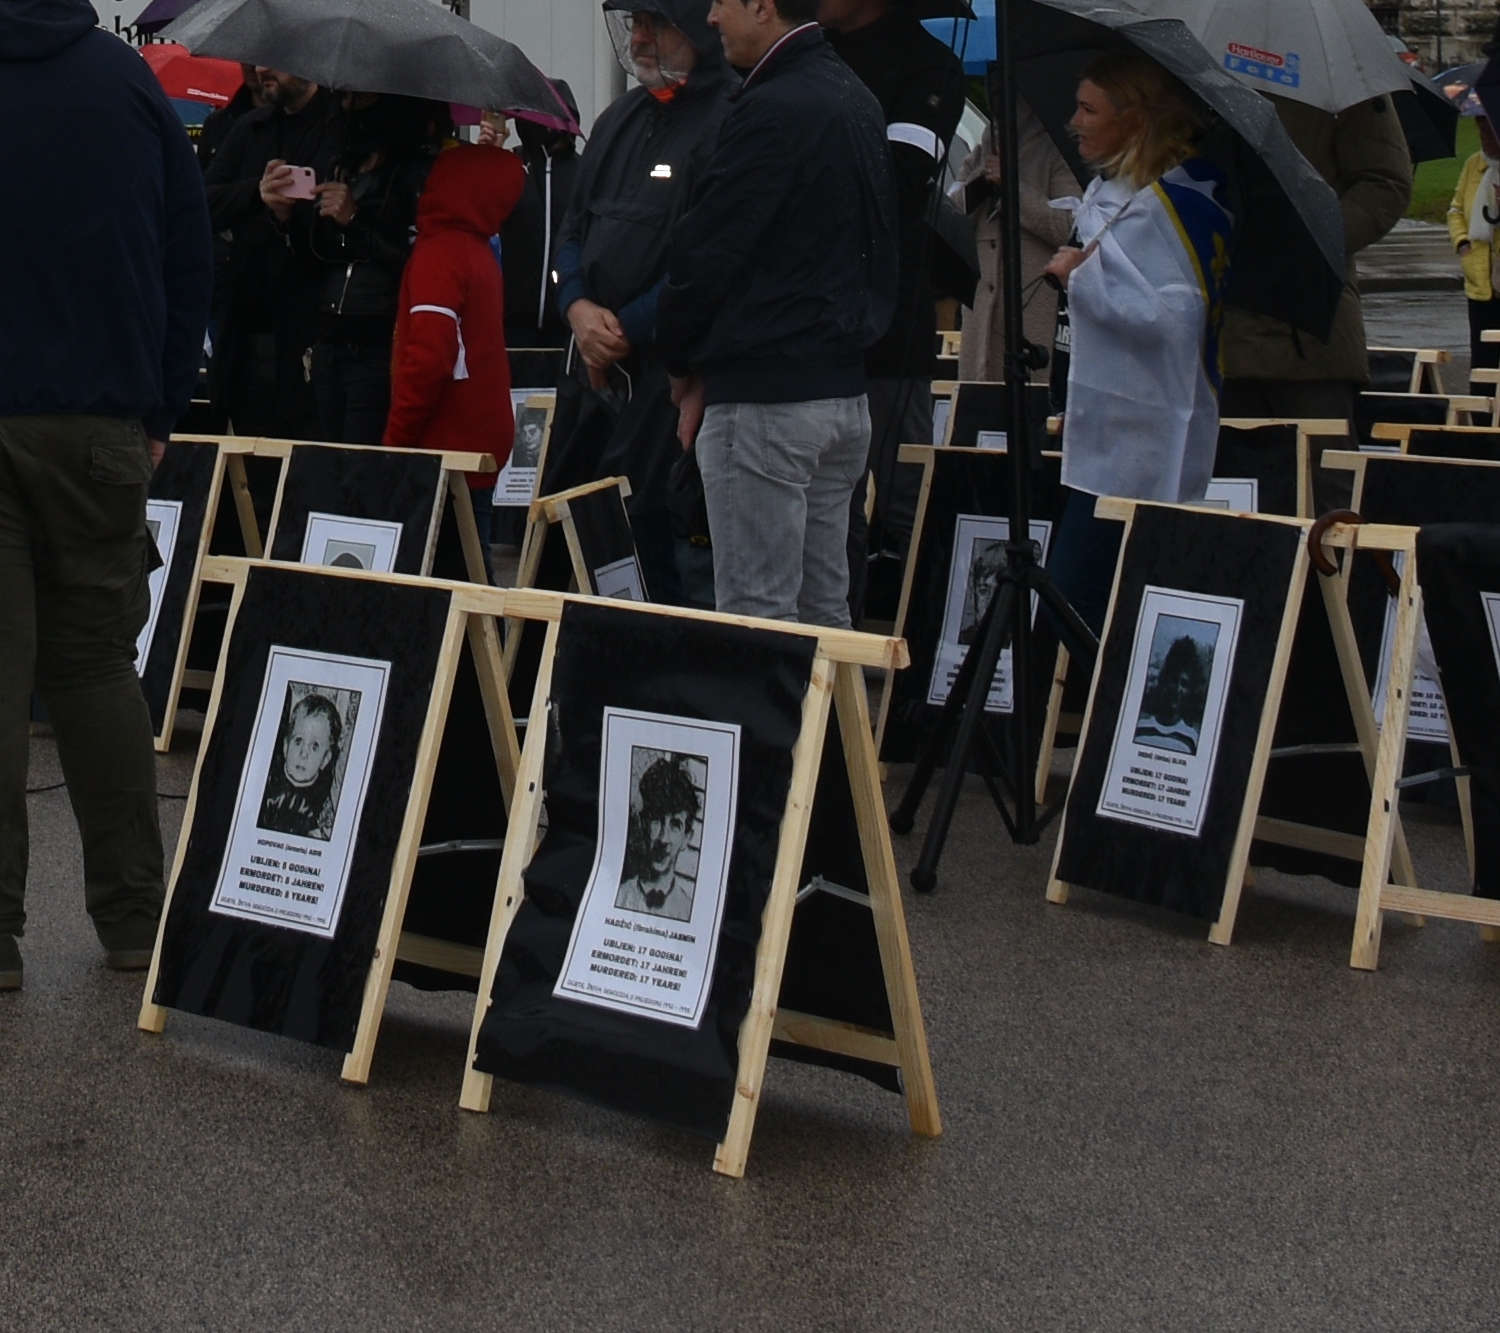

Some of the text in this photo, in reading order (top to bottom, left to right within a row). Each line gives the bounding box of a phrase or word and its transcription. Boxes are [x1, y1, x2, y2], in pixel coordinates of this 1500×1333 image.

[250, 855, 280, 868] UBIJEN:
[288, 862, 321, 876] GODINA!
[240, 866, 283, 883] ERMORDET:
[291, 877, 325, 892] JAHREN!
[239, 880, 283, 897] MURDERED:
[291, 892, 319, 905] YEARS!
[603, 938, 683, 963] UBIJEN: 17 GODINA!
[591, 949, 687, 978] ERMORDET: 17 JAHREN!
[590, 964, 681, 991] MURDERED: 17 YEARS!
